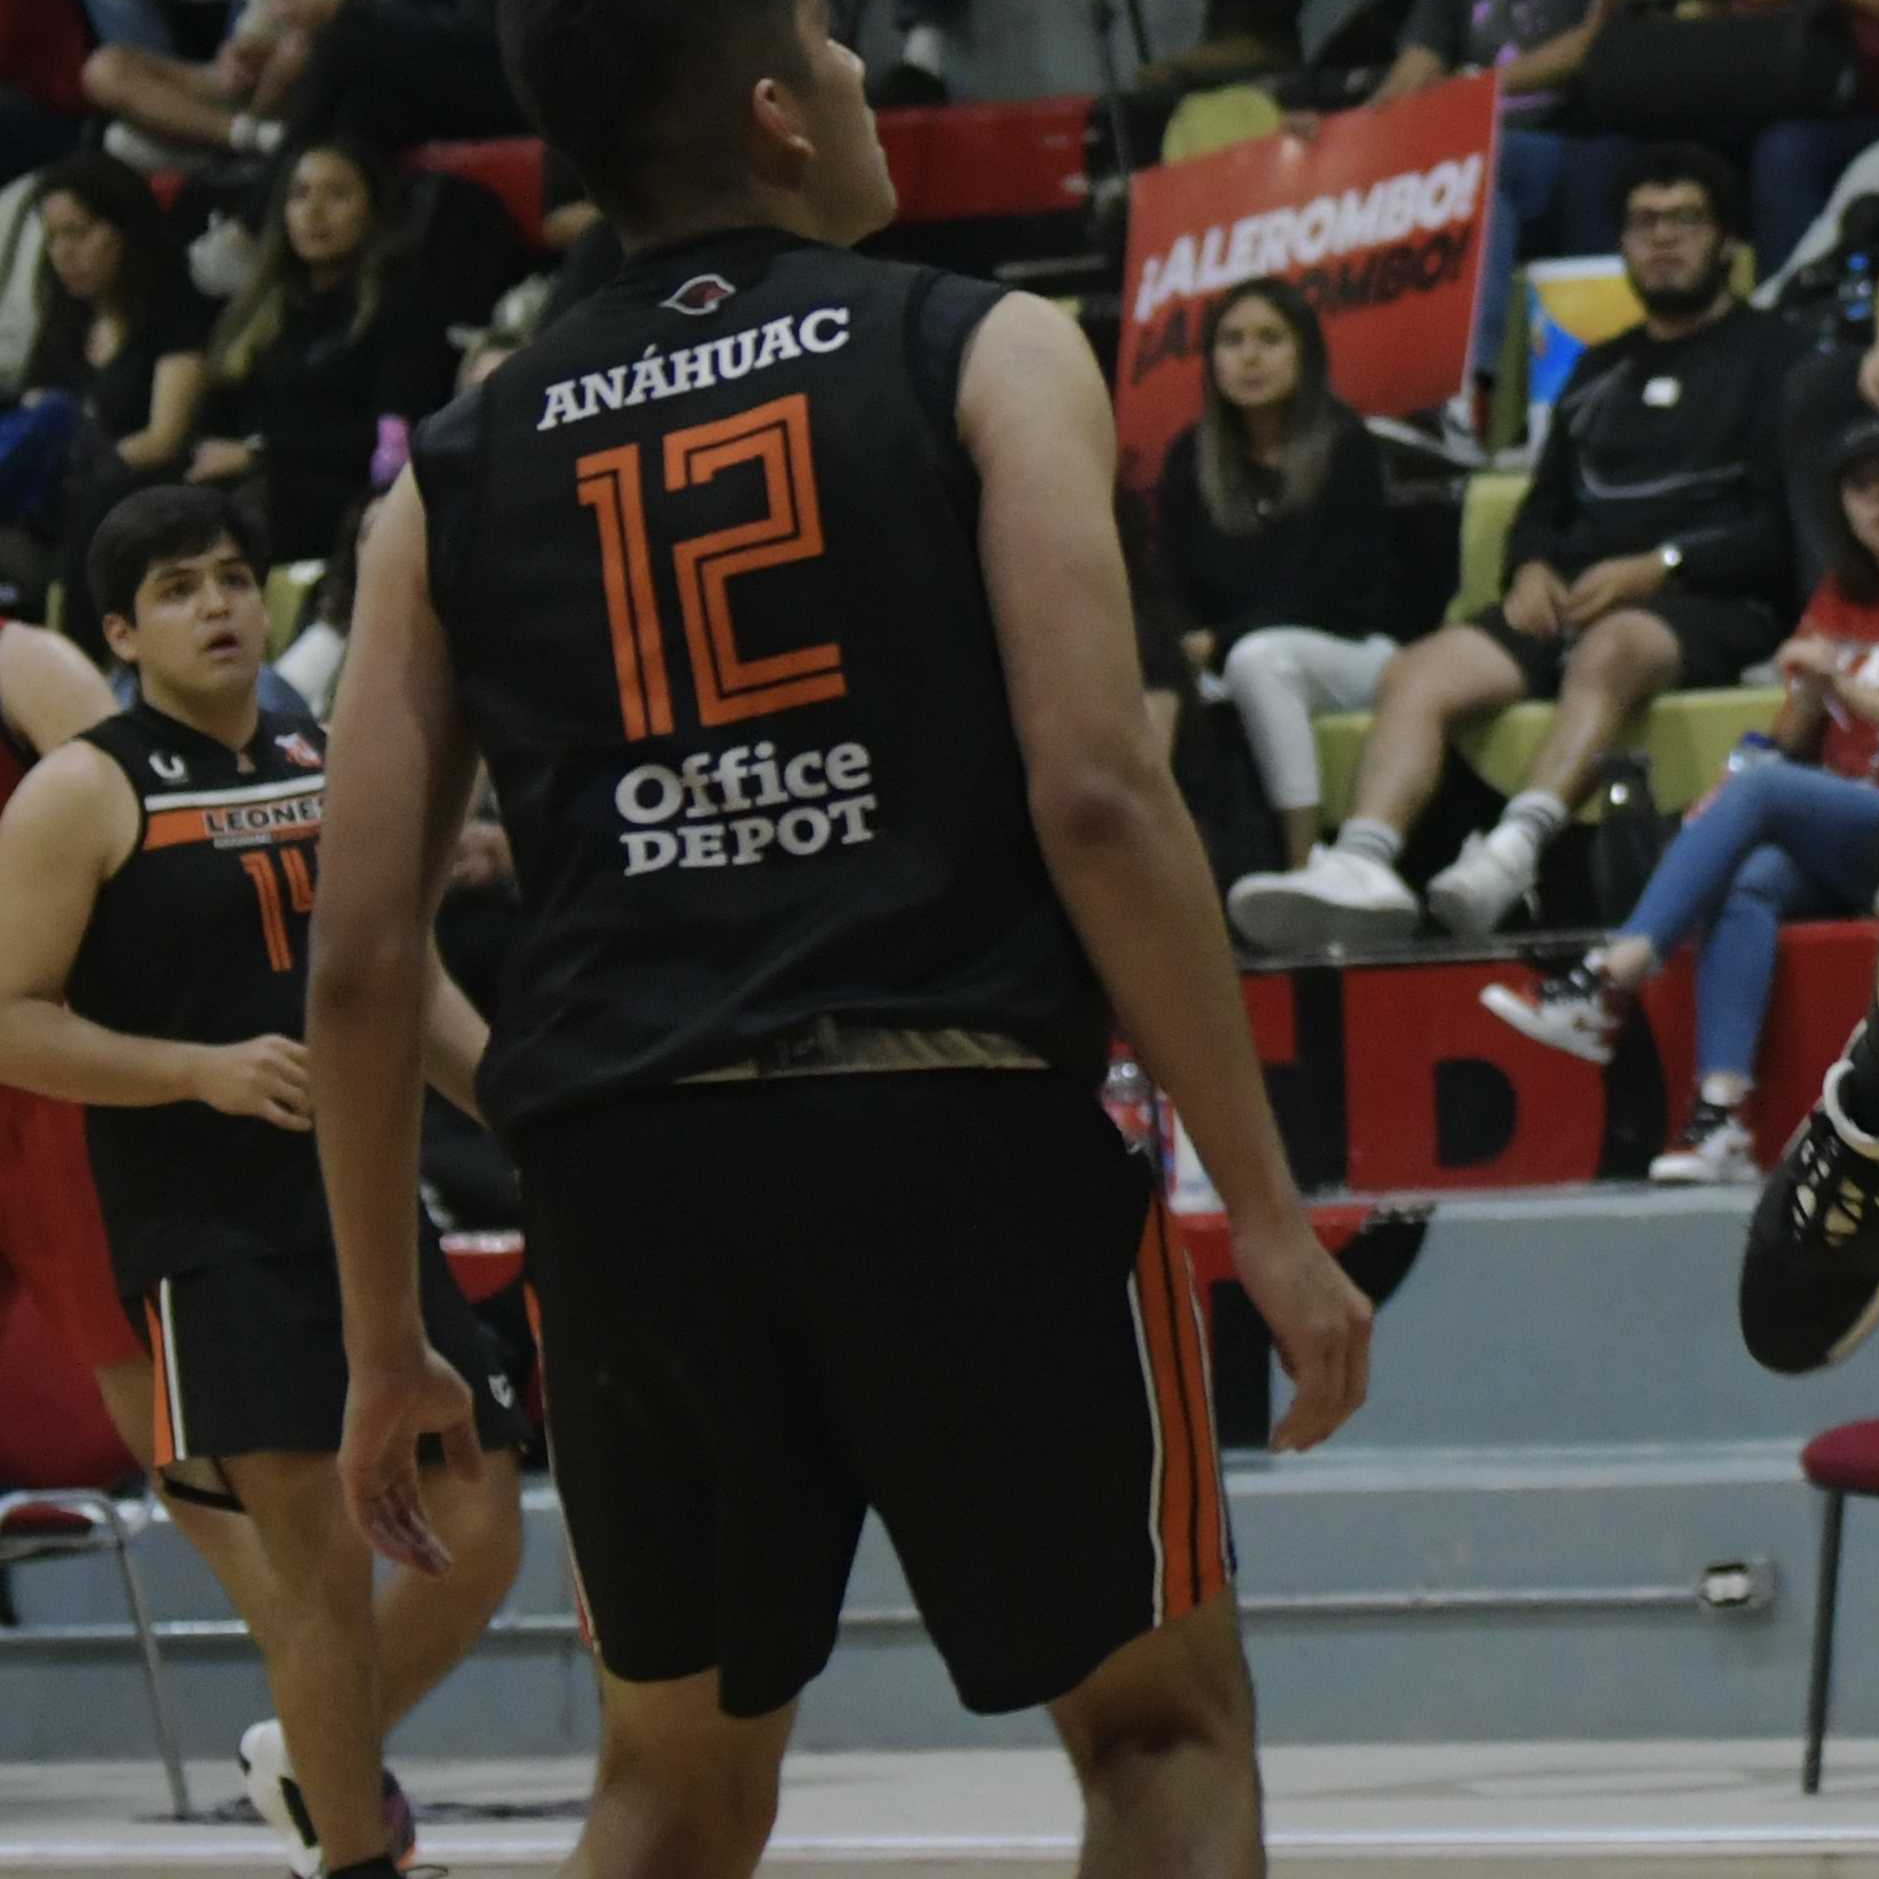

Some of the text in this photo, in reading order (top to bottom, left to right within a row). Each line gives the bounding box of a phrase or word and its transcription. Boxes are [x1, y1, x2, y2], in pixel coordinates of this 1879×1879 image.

[536, 306, 852, 432] ANÁHUAC
[575, 391, 849, 744] 12
[205, 798, 323, 834] LEONE
[614, 739, 873, 825] Office
[617, 793, 880, 878] DEPOT
